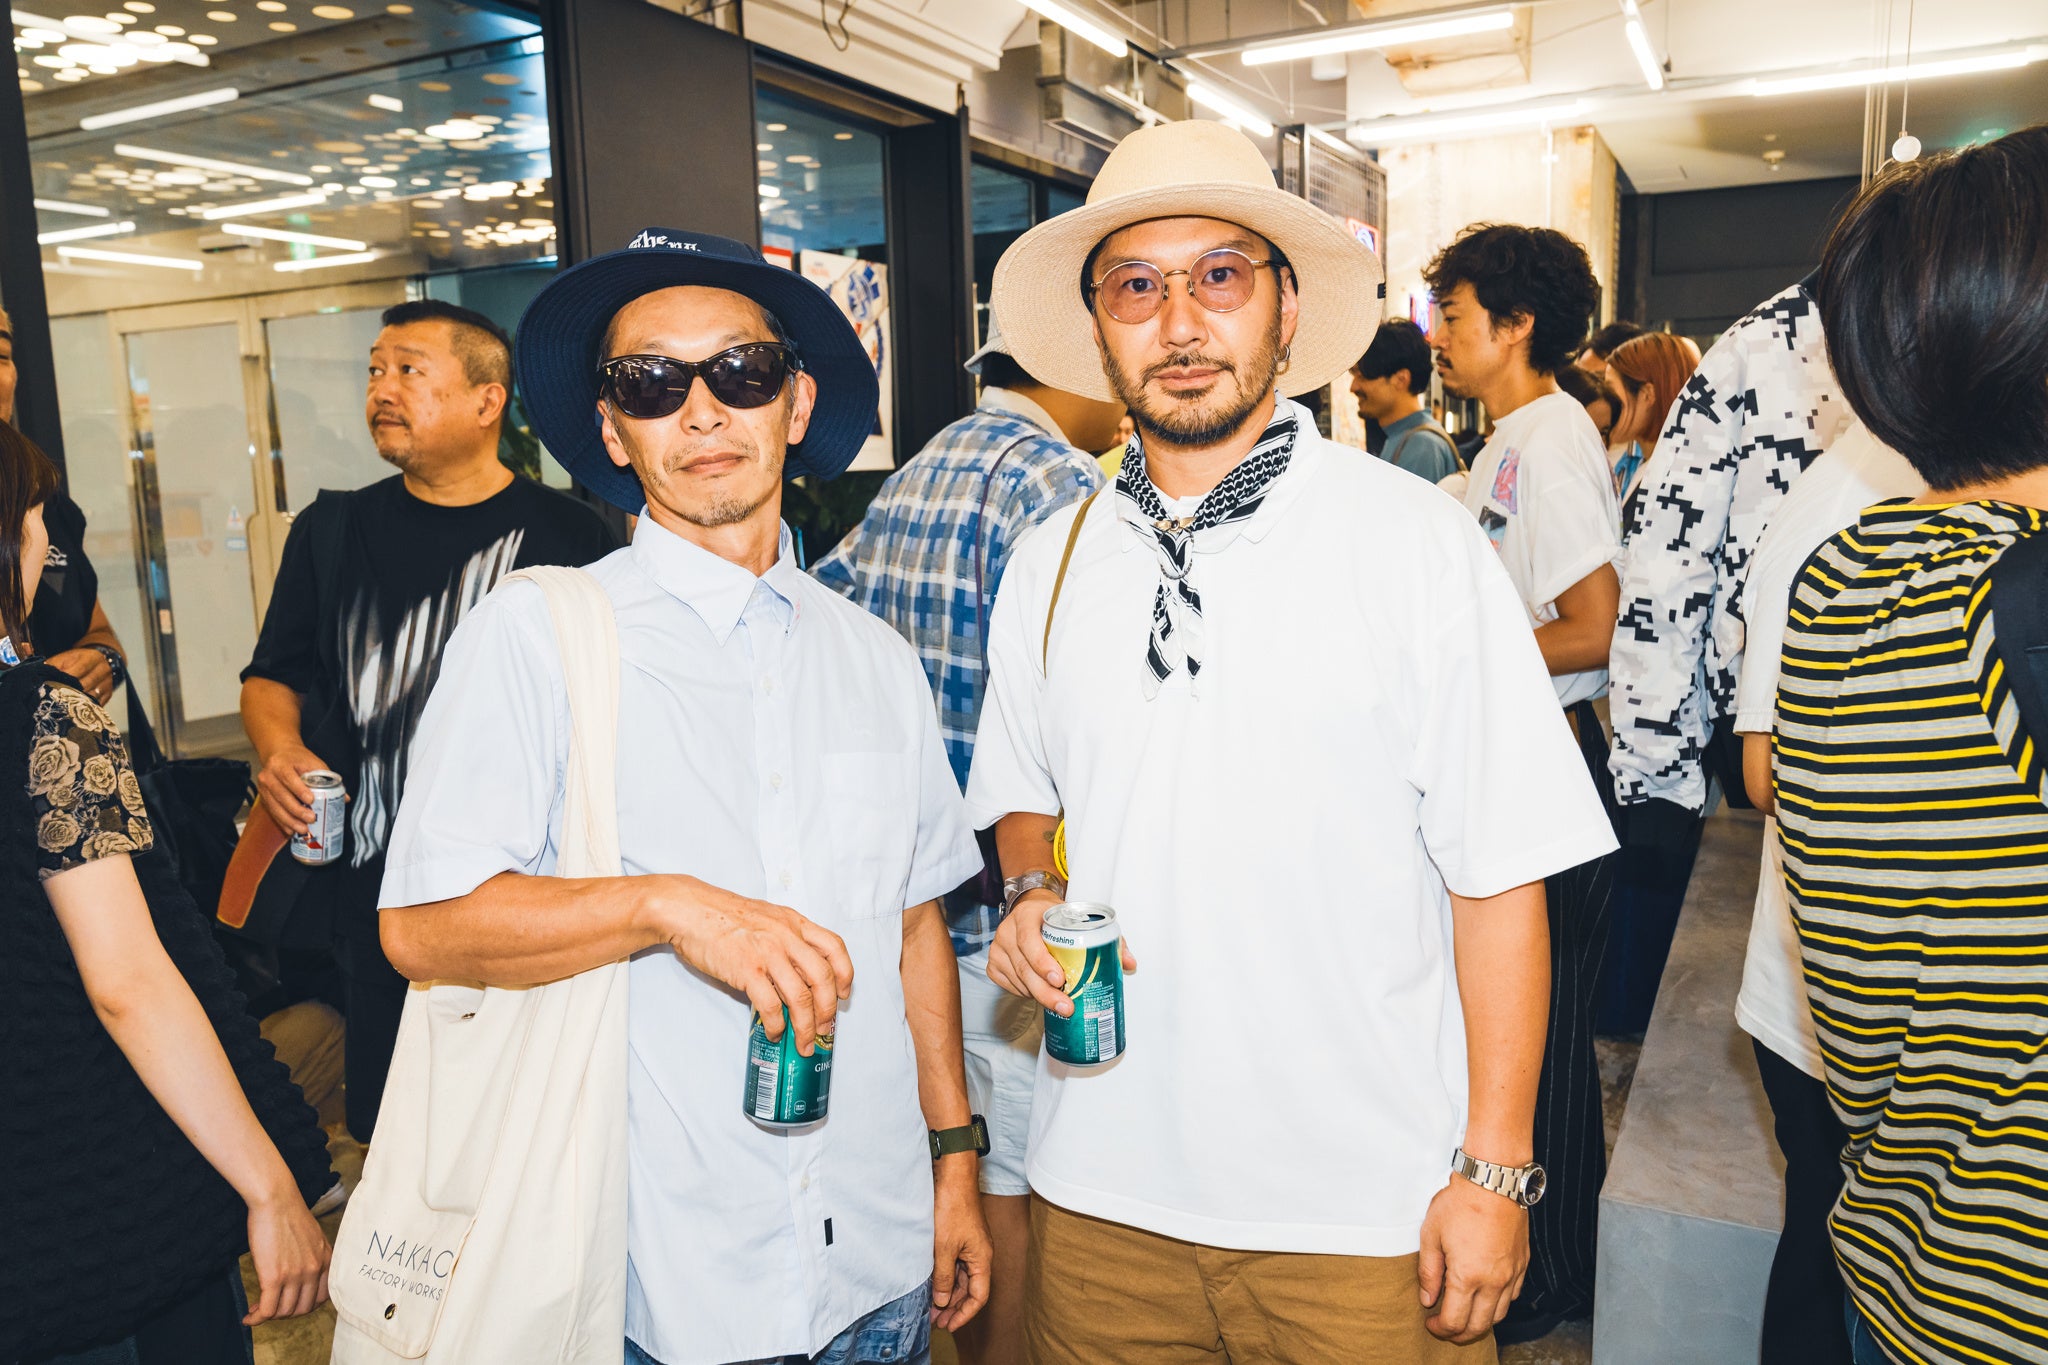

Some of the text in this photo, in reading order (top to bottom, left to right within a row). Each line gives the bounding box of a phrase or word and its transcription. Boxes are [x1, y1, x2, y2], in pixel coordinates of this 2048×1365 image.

[367, 1230, 455, 1278] NAKAC
[359, 1264, 444, 1301] FACTORY WORKS
